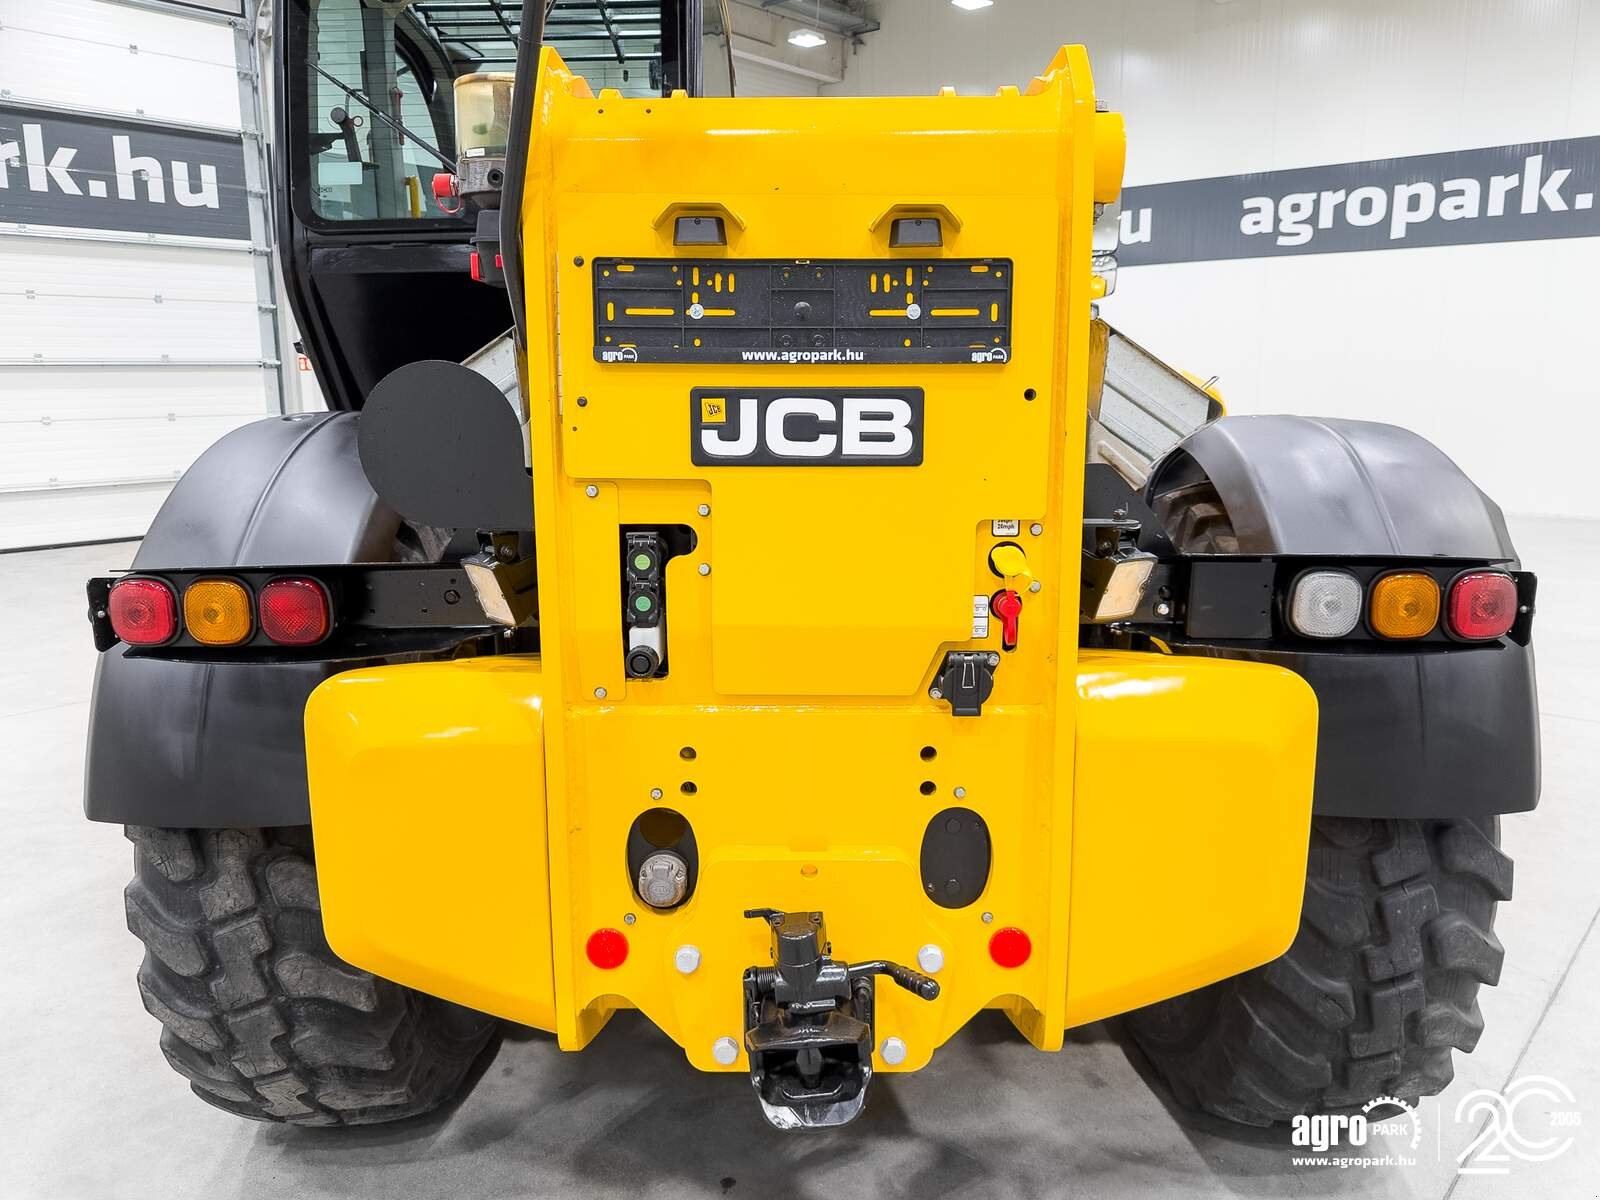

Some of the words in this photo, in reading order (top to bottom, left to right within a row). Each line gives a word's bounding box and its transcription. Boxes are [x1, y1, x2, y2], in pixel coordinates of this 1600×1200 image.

[1240, 154, 1593, 246] agropark.
[602, 351, 623, 363] agro
[741, 348, 864, 363] www.agropark.hu
[971, 352, 992, 363] agro
[700, 397, 914, 457] JCB
